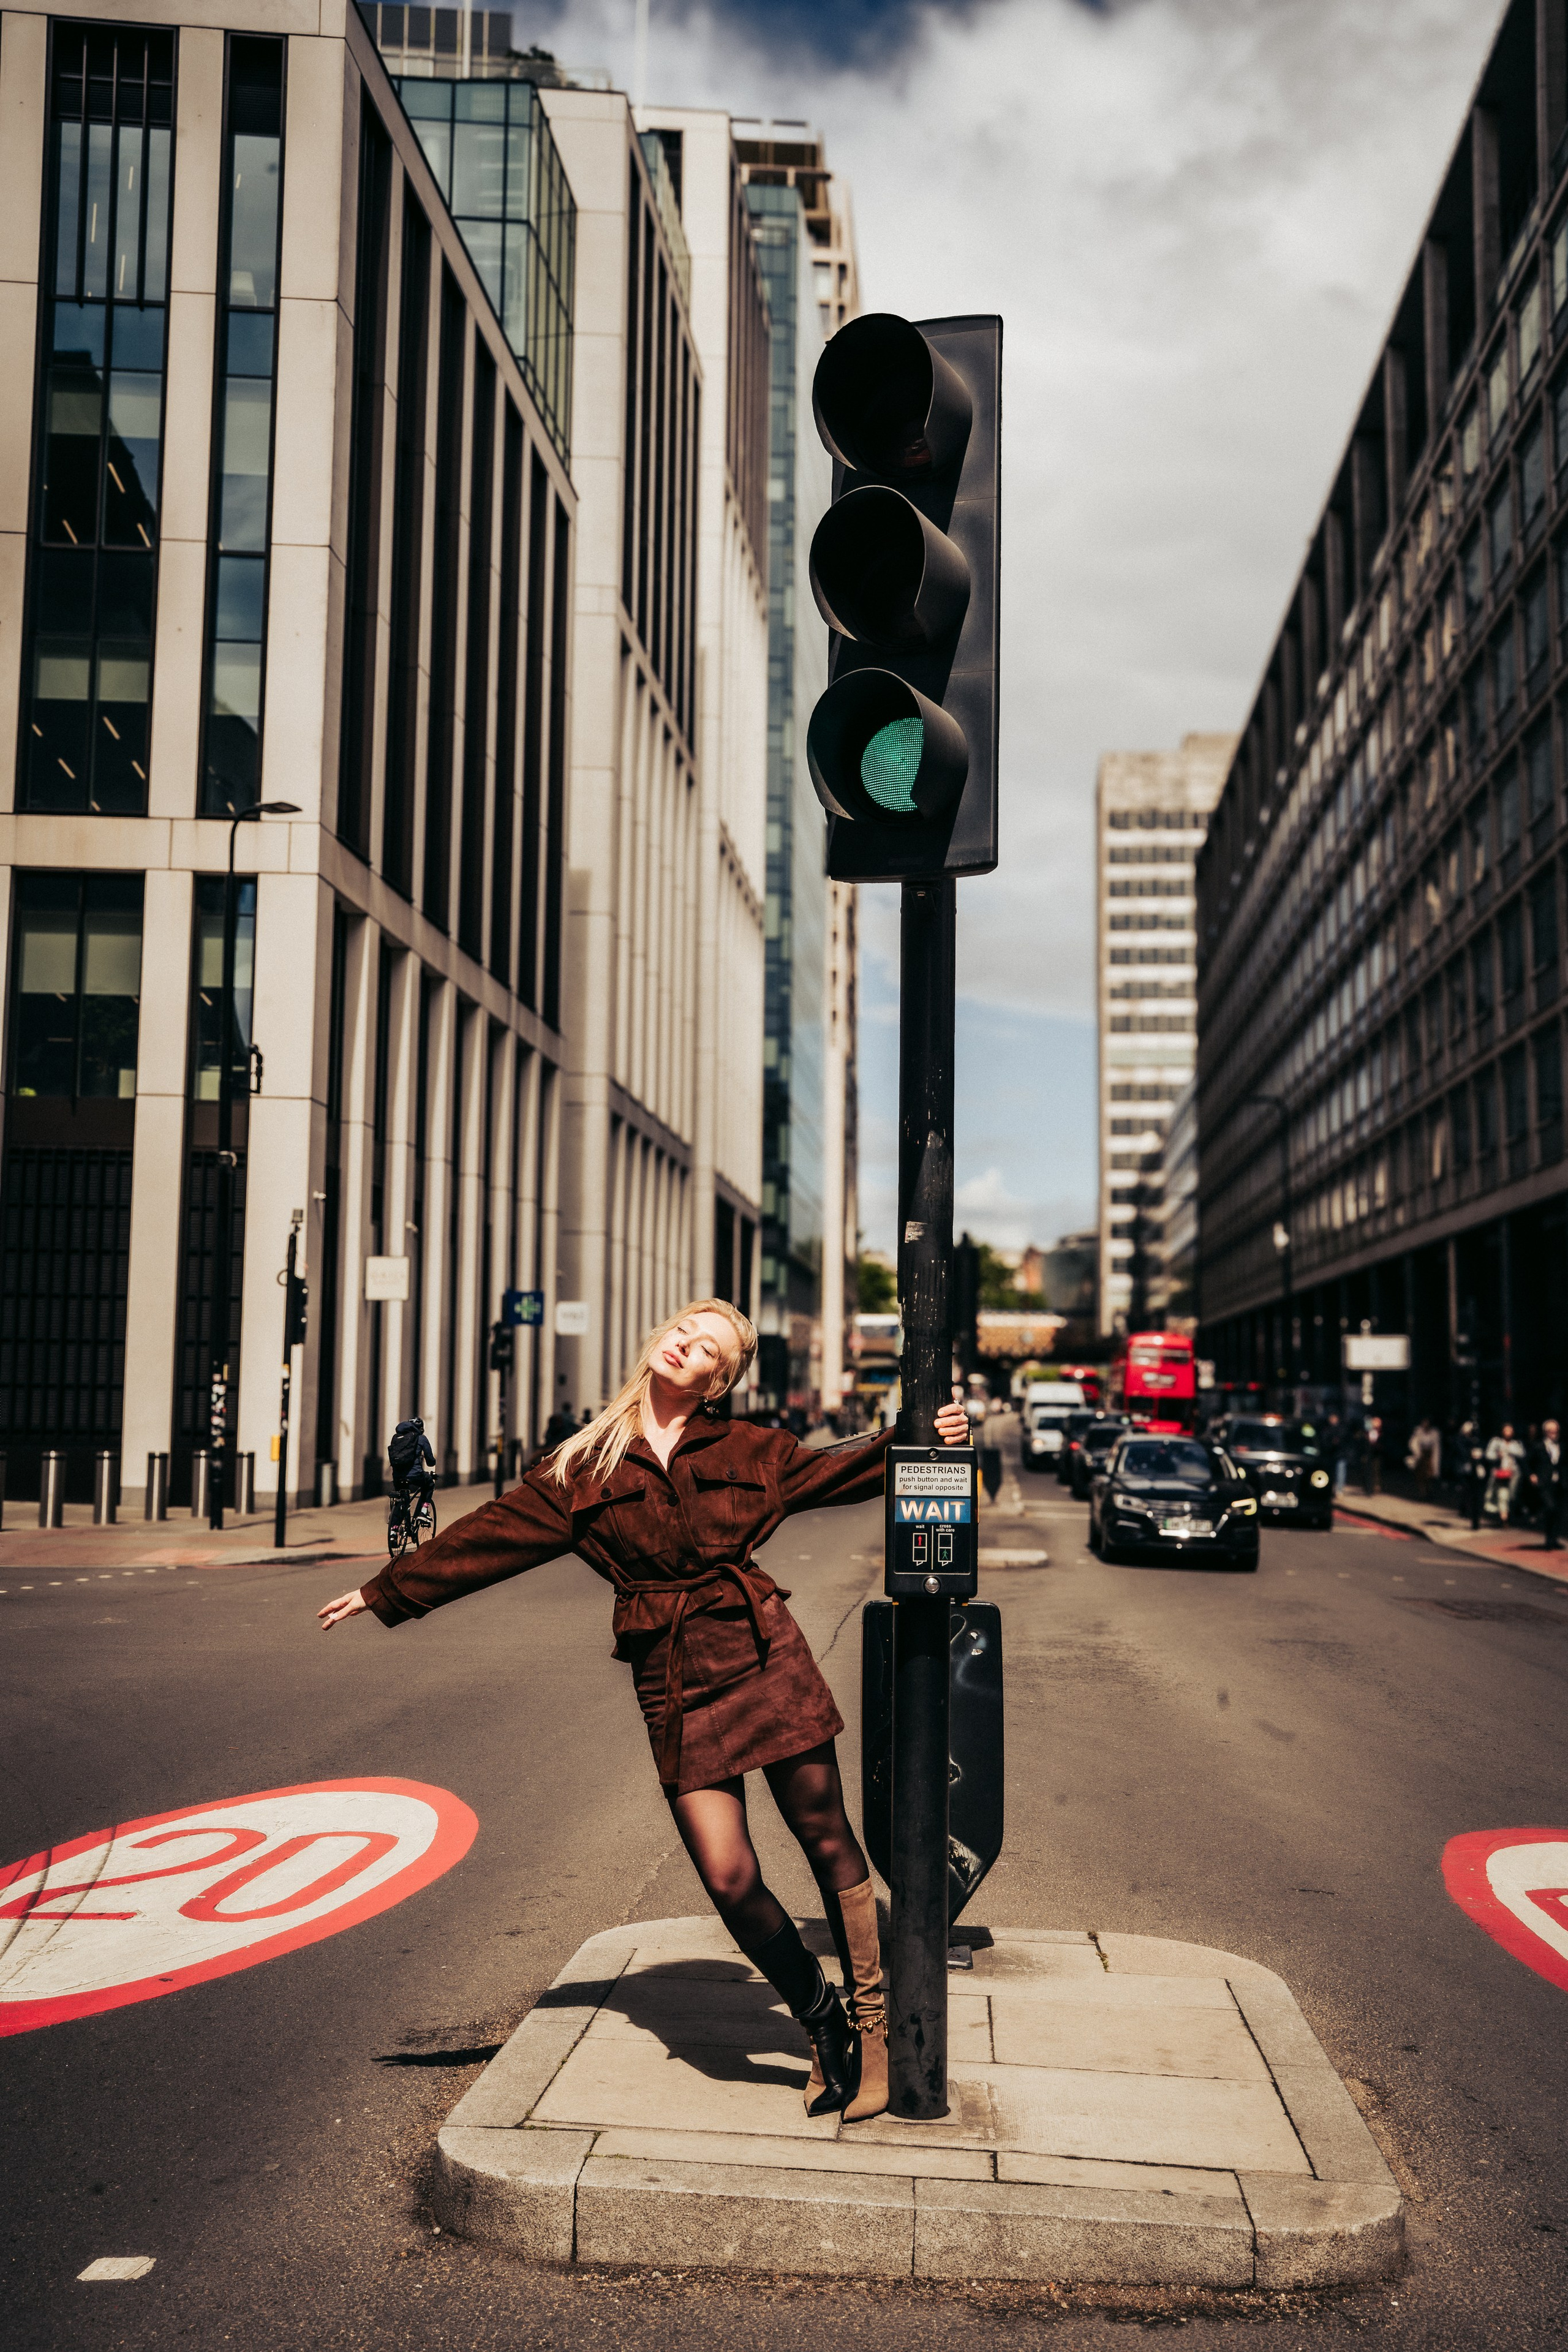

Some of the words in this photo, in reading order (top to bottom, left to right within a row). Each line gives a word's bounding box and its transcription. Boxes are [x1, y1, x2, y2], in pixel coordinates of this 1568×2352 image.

[901, 1466, 966, 1474] PEDESTRIANS
[900, 1500, 965, 1521] WAIT
[0, 1828, 399, 1923] 20
